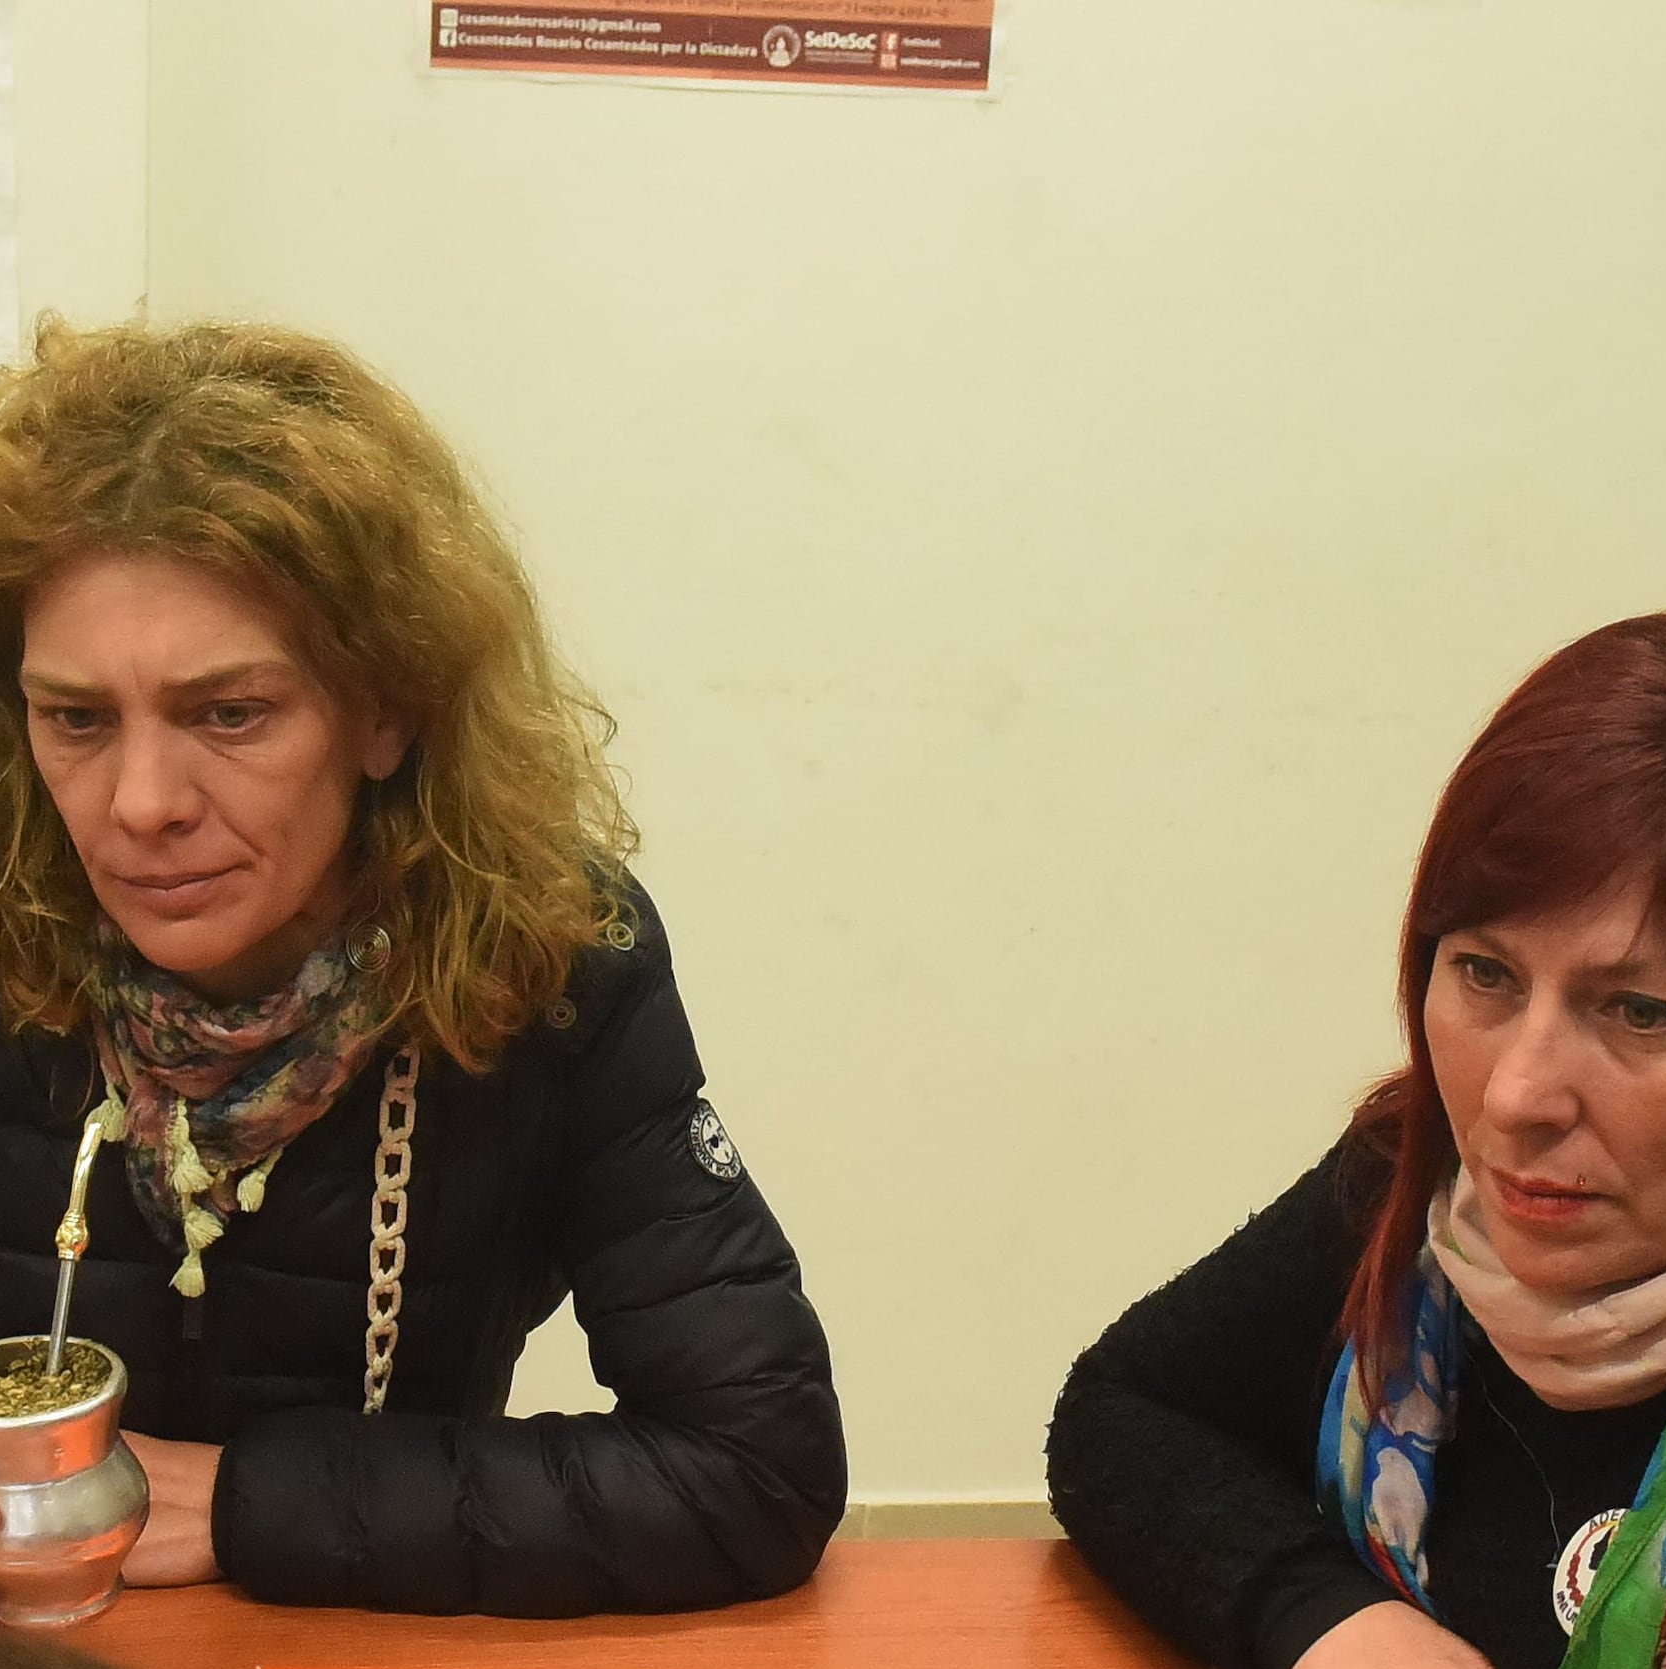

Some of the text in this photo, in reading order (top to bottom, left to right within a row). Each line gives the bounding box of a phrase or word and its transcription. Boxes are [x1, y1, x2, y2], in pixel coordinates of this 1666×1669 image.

[458, 32, 533, 48] Cesanteados
[535, 35, 582, 50] Rosario
[584, 38, 660, 54] Cesanteados
